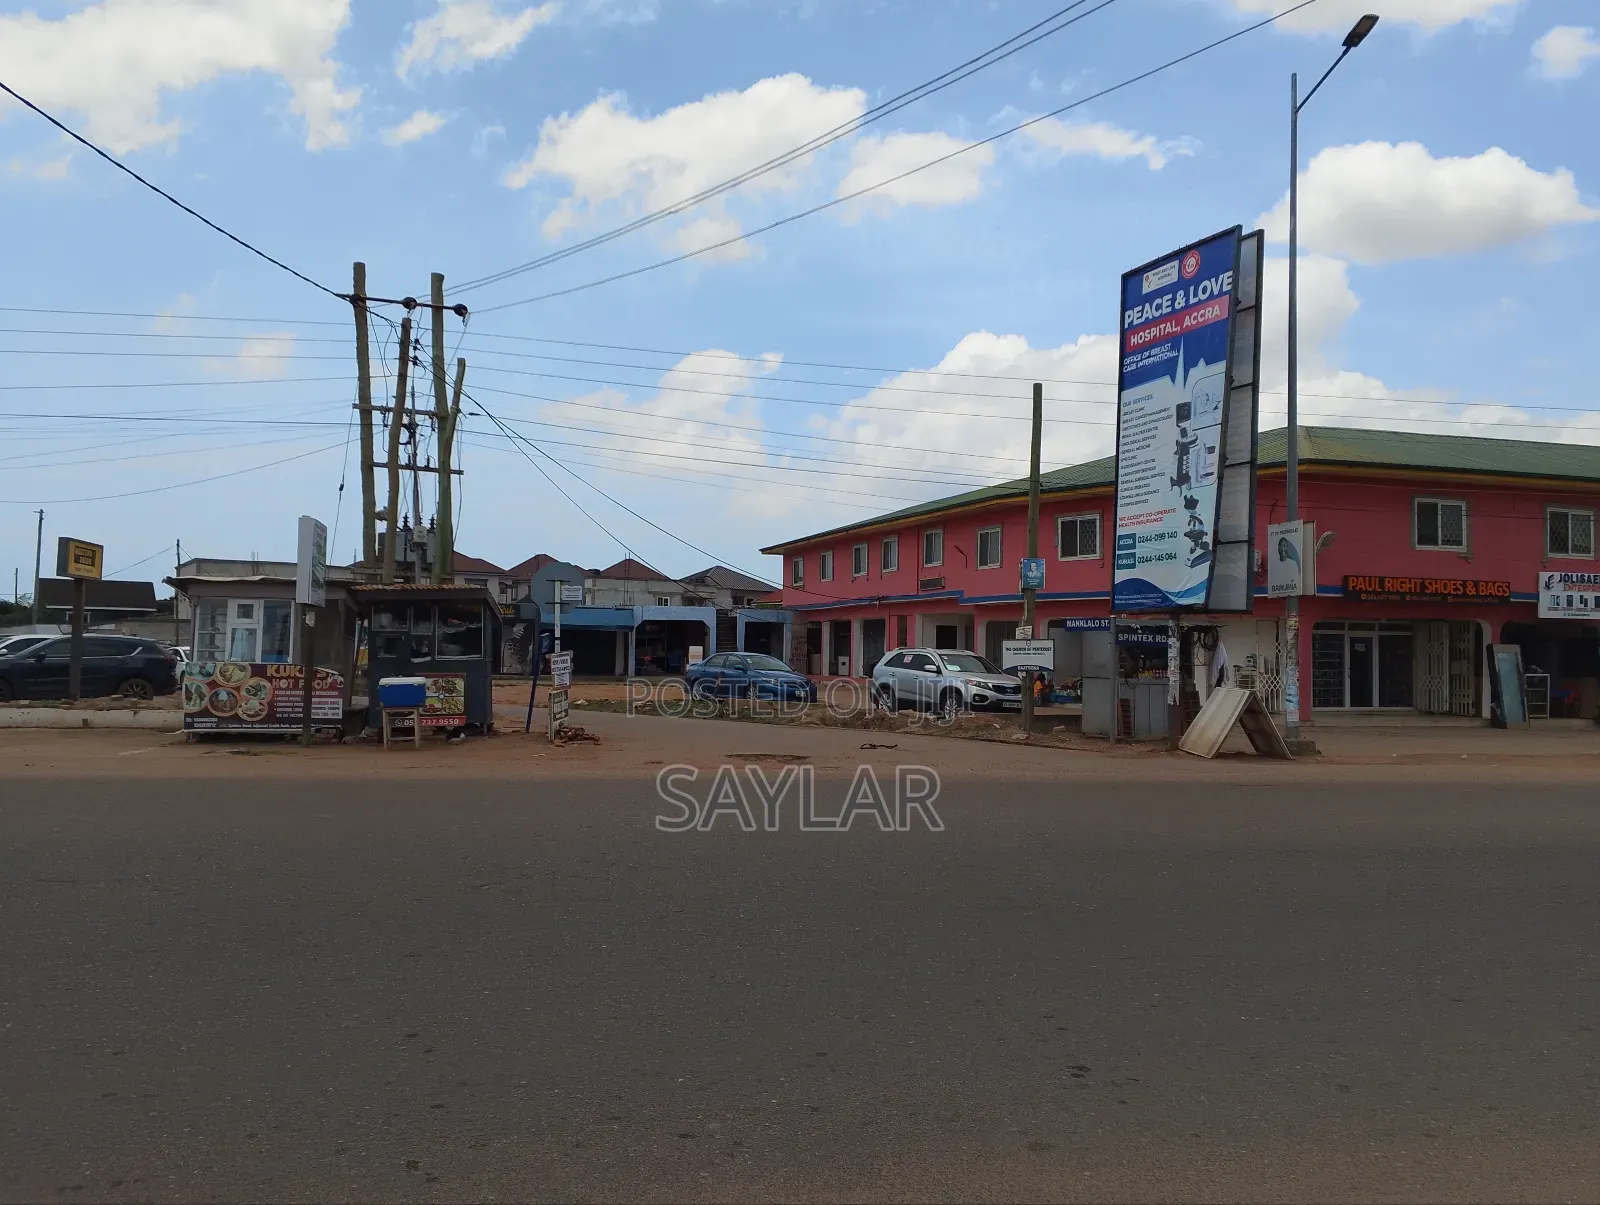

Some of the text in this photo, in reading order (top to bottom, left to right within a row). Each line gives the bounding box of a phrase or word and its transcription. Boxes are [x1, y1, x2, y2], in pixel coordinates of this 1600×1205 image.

[1124, 270, 1234, 329] PEACE & LOVE
[1130, 304, 1221, 347] HOSPITAL, ACCRA
[1123, 344, 1171, 365] OFFICE OF BREAST
[1122, 348, 1179, 373] CARE INTERNATIONAL
[1126, 513, 1145, 521] ACCEPT
[1135, 517, 1163, 526] INSURANCE
[1118, 536, 1134, 546] ACCRA
[1167, 530, 1178, 540] 140
[1137, 553, 1164, 564] 0244-145
[1558, 573, 1600, 584] JOLISAE
[1347, 576, 1511, 597] PAUL RIGHT SHOES & BAGS
[1066, 619, 1110, 628] MANKLALO ST.
[1118, 633, 1169, 643] SPINTEX RD.
[272, 679, 330, 690] HOT FOD
